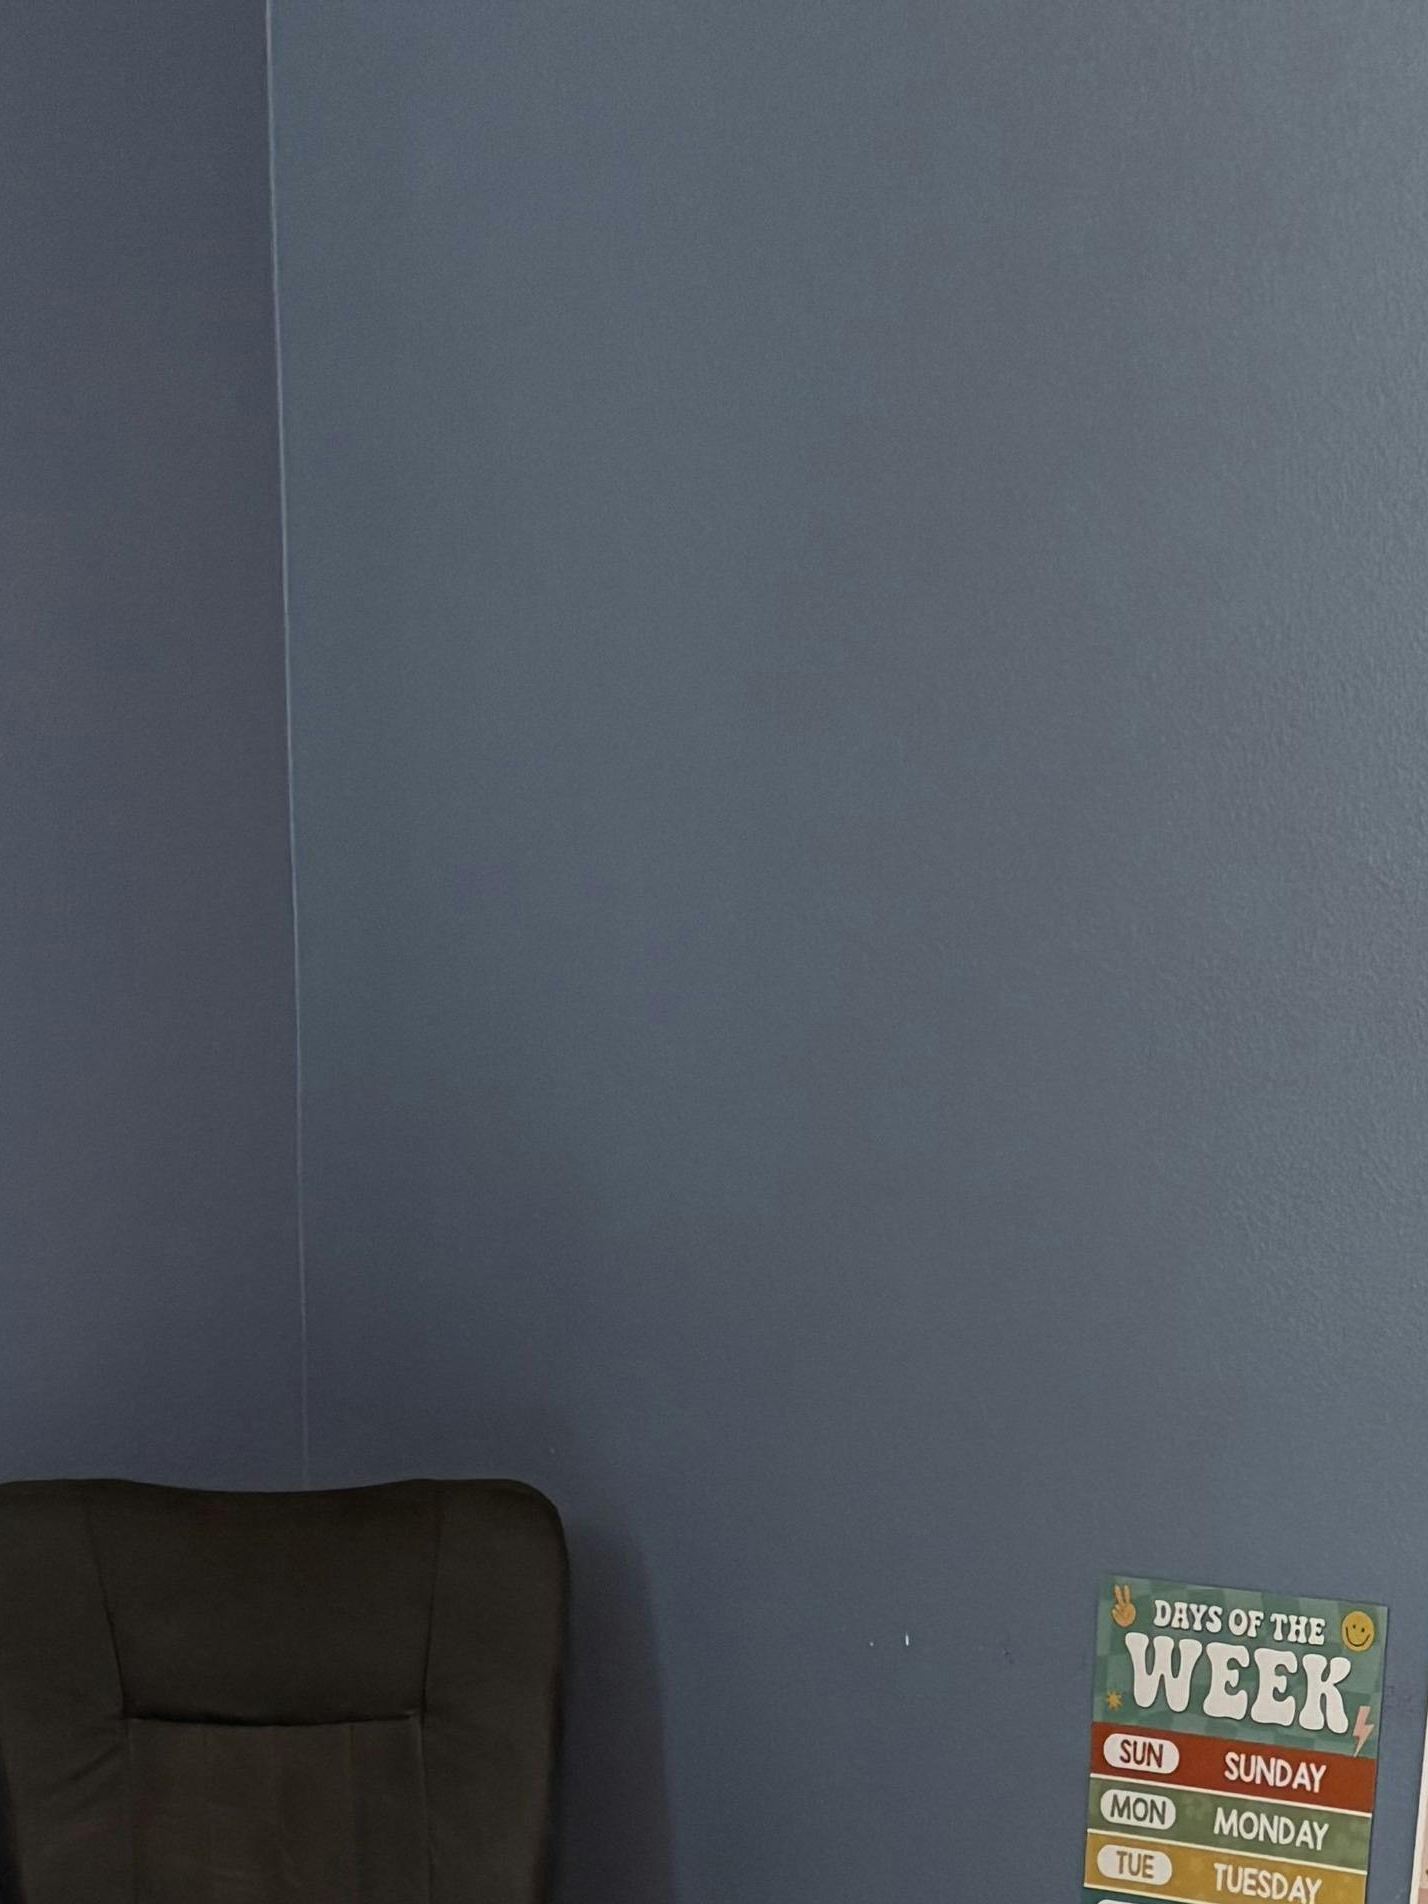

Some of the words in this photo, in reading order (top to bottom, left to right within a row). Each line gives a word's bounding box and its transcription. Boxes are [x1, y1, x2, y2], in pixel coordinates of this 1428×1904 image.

[1153, 1600, 1223, 1633] DAYS
[1228, 1609, 1264, 1638] OF
[1271, 1613, 1326, 1645] THE
[1124, 1632, 1351, 1734] WEEK
[1120, 1740, 1164, 1769] SUN
[1224, 1752, 1326, 1793] SUNDAY
[1110, 1794, 1166, 1825] MON
[1213, 1807, 1330, 1851] MONDAY
[1115, 1850, 1154, 1879] TUE
